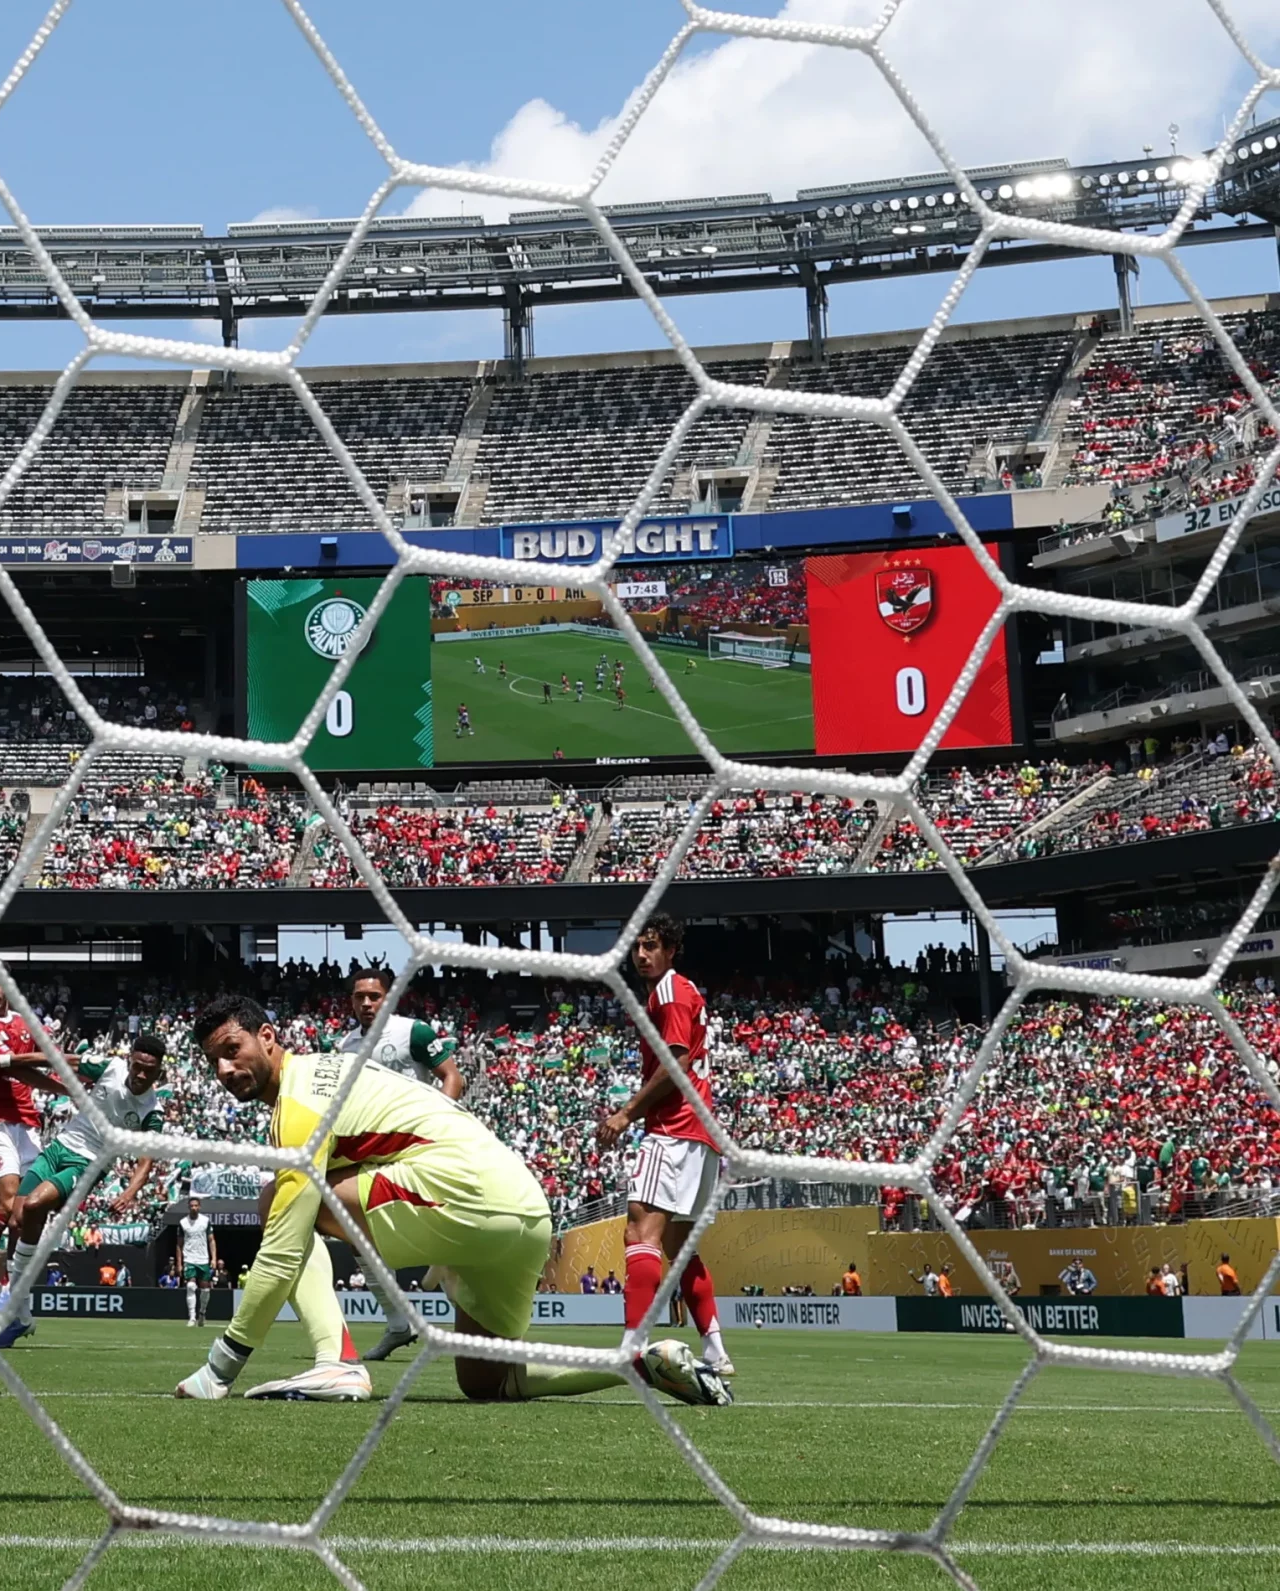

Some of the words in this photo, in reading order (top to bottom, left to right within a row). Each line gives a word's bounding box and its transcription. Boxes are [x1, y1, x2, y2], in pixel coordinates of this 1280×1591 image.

[1184, 506, 1211, 533] 32
[11, 545, 25, 554] 1938
[28, 545, 41, 554] 1956
[138, 545, 154, 554] 2007
[174, 545, 189, 554] 2011
[514, 529, 596, 559] BUD
[601, 522, 718, 554] LIGHT
[473, 589, 493, 602] SEP
[515, 590, 522, 601] 0
[536, 588, 544, 600] 0
[565, 587, 586, 599] AHL
[626, 584, 658, 595] 17:48
[896, 667, 925, 715] 0
[326, 690, 353, 736] 0
[41, 1293, 124, 1313] BETTER
[735, 1301, 786, 1324] INVESTED
[787, 1303, 799, 1324] IN
[800, 1303, 840, 1326] BETTER
[1027, 1305, 1043, 1328] IN
[1045, 1306, 1099, 1330] BETTER
